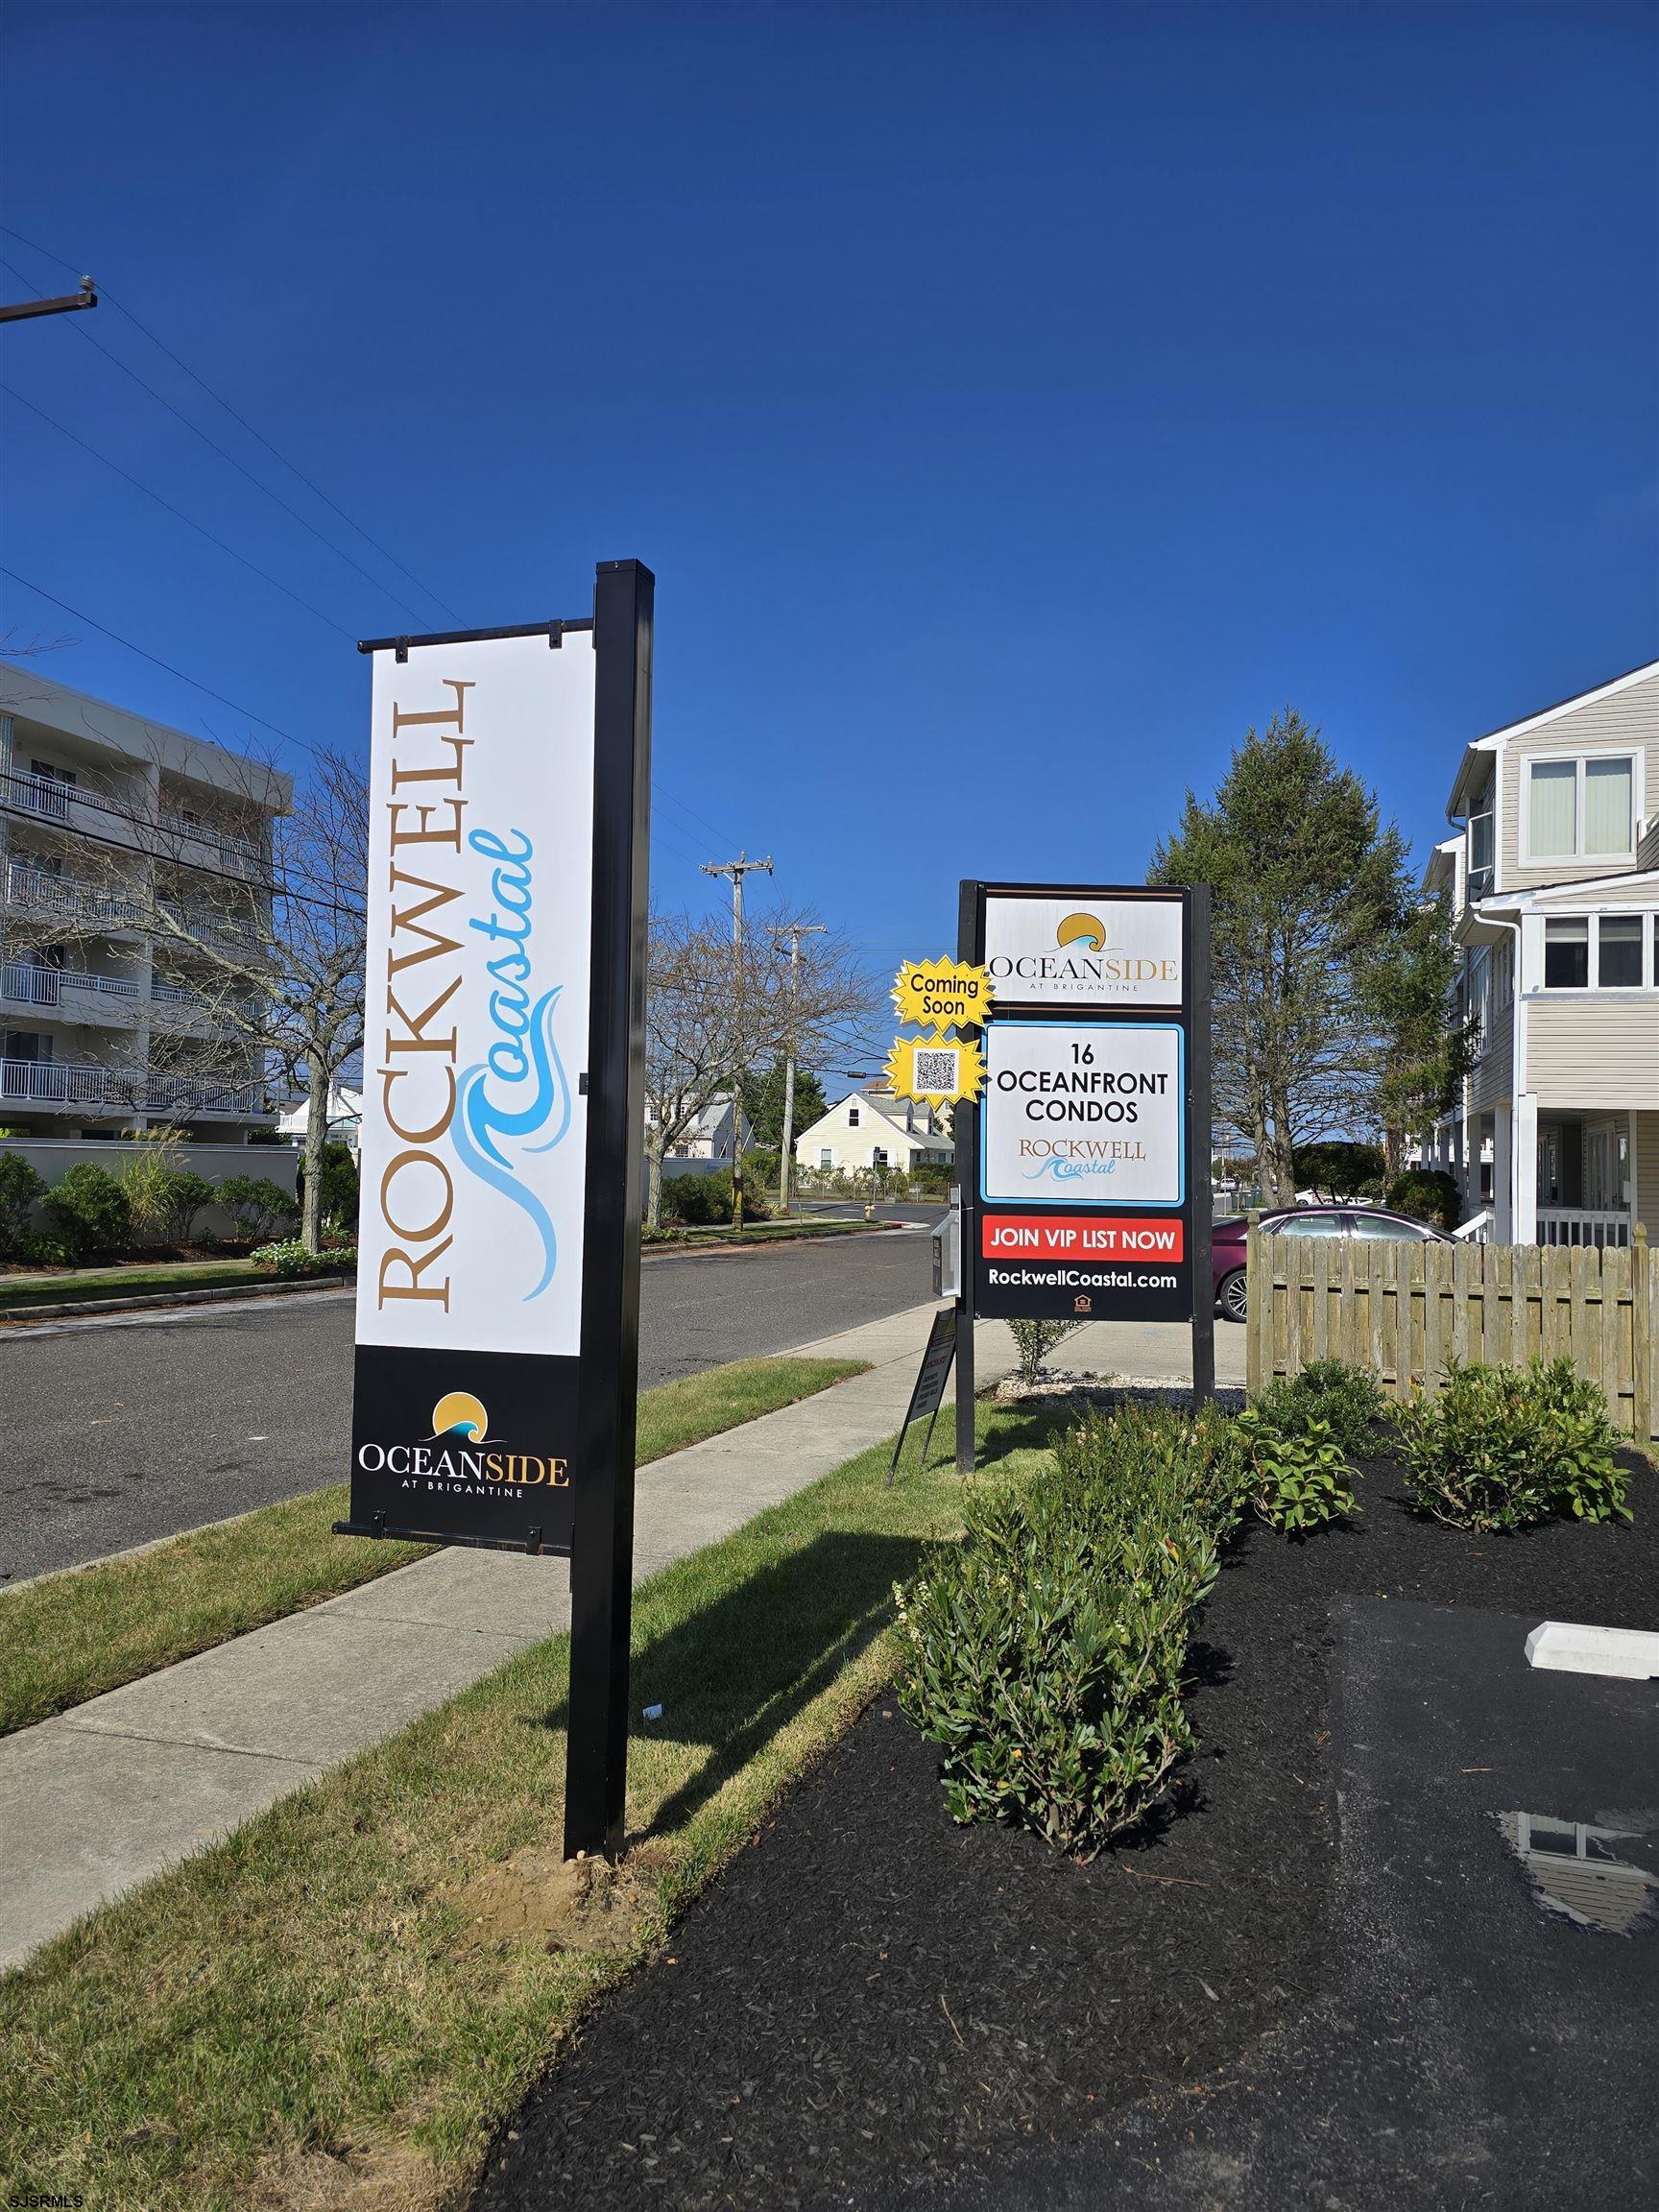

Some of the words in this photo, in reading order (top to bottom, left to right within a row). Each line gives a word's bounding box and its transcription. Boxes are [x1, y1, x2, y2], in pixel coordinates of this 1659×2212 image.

[989, 955, 1178, 981] OCEANSIDE
[376, 678, 476, 1313] ROCKWELL
[910, 973, 978, 998] Coming
[1053, 982, 1139, 992] BRIGANTINE
[467, 827, 565, 1171] Coastal
[922, 995, 965, 1015] Soon
[1070, 1043, 1094, 1065] 16
[997, 1070, 1168, 1095] OCEANFRONT
[1025, 1099, 1139, 1123] CONDOS
[1018, 1139, 1146, 1161] ROCKWELL
[1046, 1157, 1116, 1180] Coastal
[990, 1228, 1040, 1247] JOIN
[1045, 1229, 1077, 1247] VIP
[1082, 1230, 1118, 1249] LIST
[1121, 1231, 1176, 1250] NOW
[988, 1268, 1177, 1288] RockwellCoastal.com
[358, 1443, 570, 1487] OCEANSIDE
[401, 1479, 418, 1489] AT
[427, 1480, 524, 1499] BRIGANTINE
